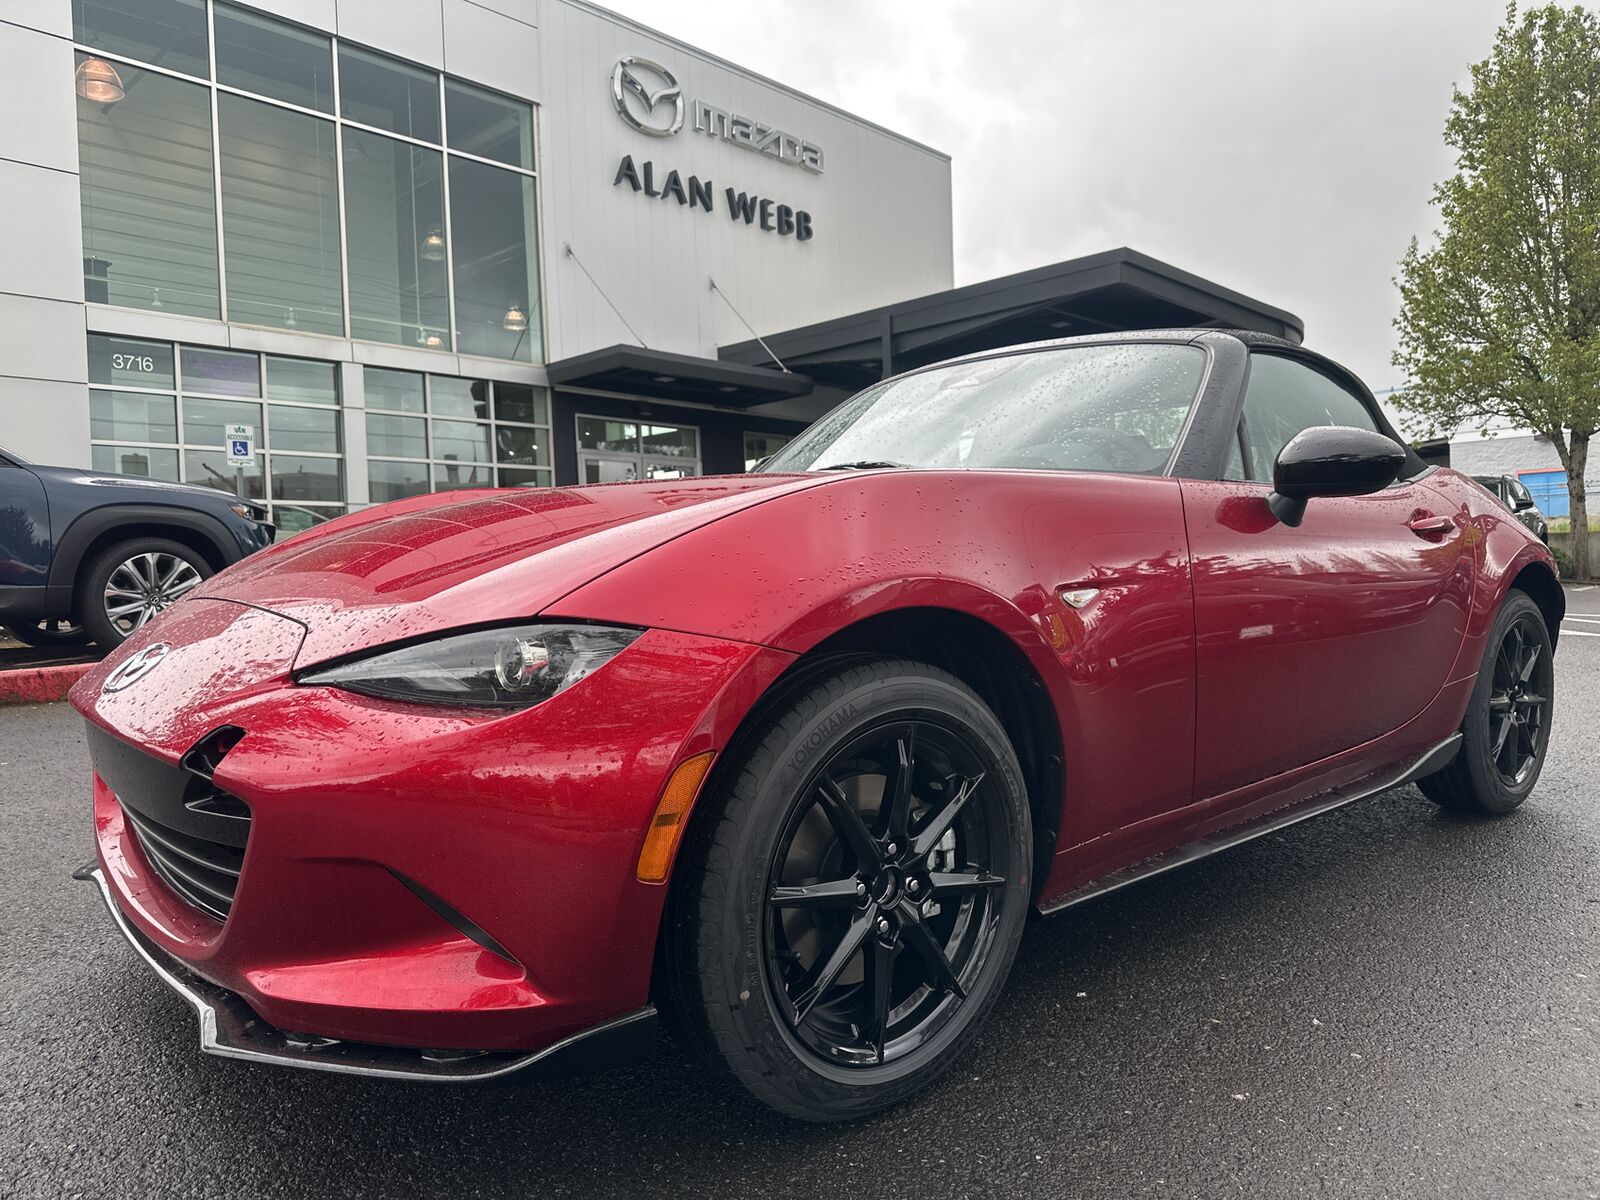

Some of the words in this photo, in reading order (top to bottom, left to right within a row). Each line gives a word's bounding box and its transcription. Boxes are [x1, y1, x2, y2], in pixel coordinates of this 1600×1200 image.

[613, 154, 713, 213] ALAN
[725, 187, 813, 241] WEBB
[112, 354, 153, 372] 3716
[787, 703, 859, 770] YOKOHAMA
